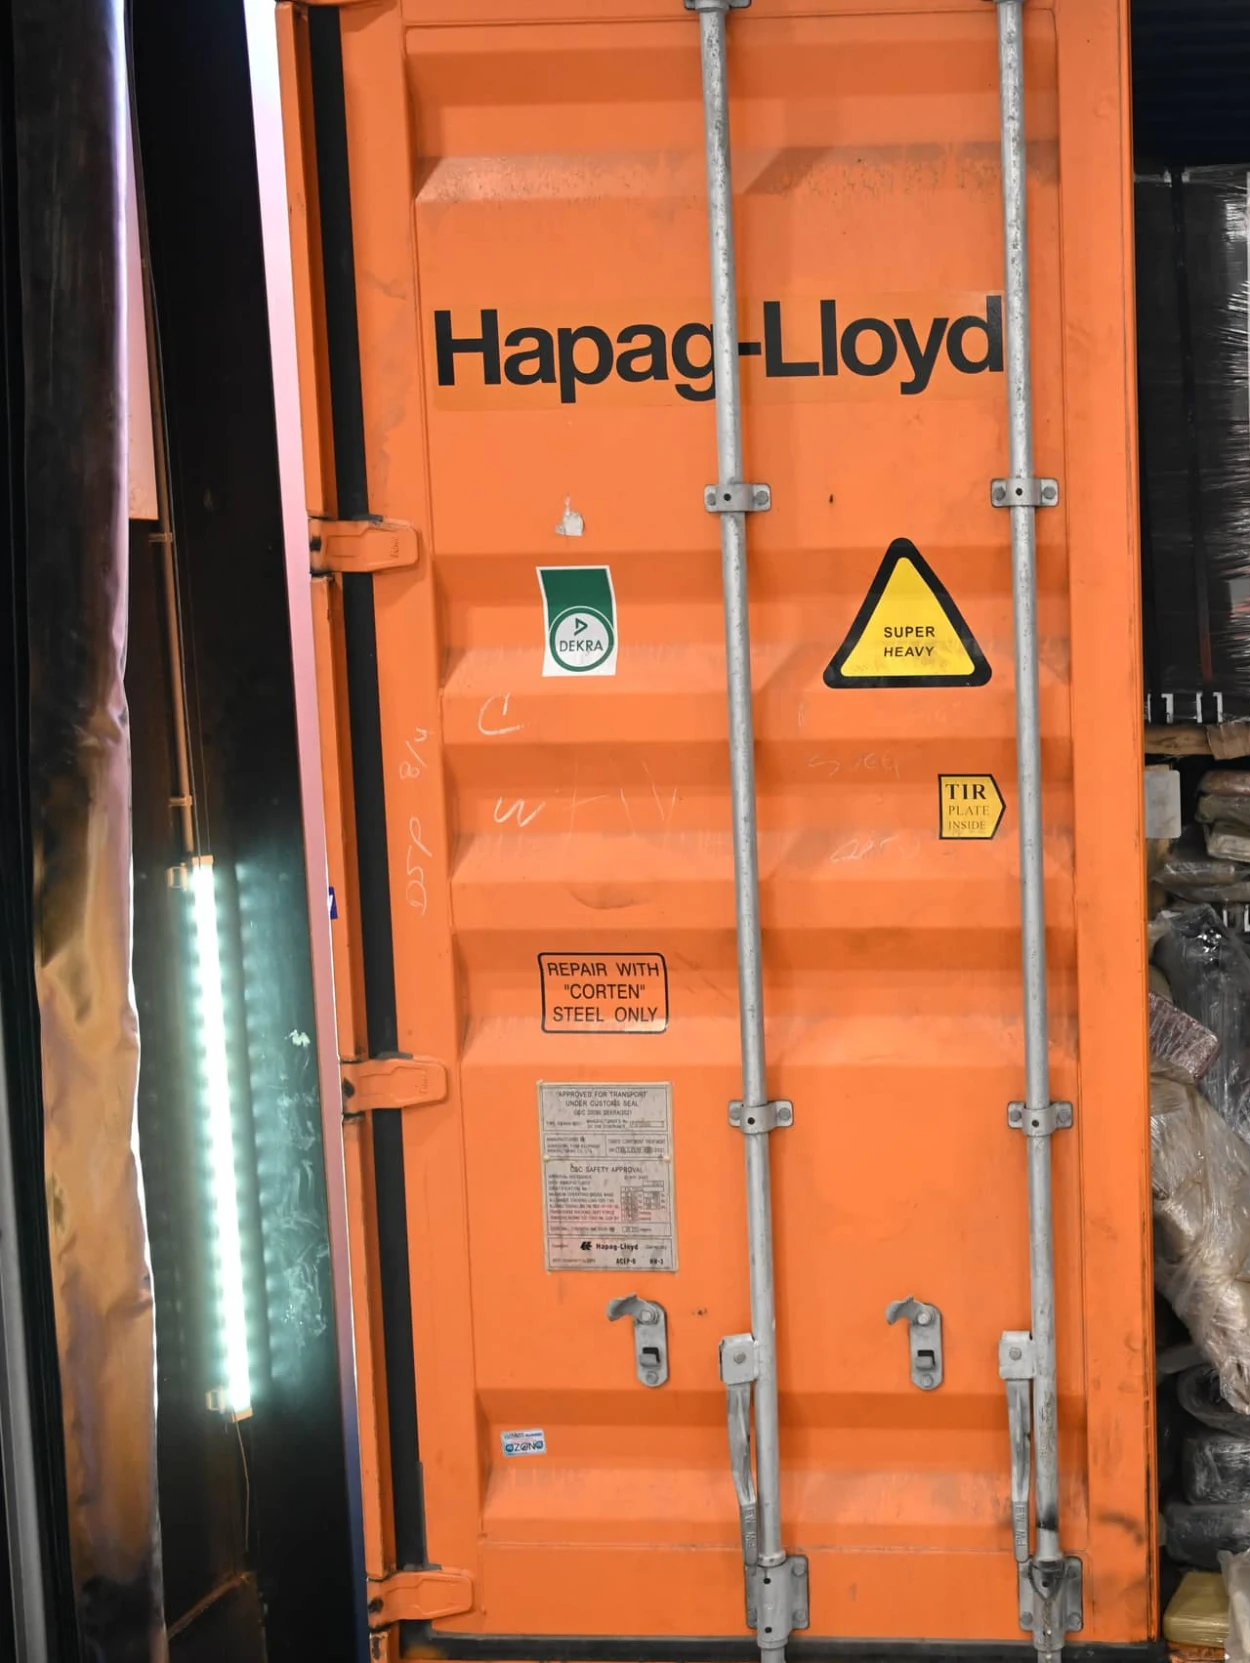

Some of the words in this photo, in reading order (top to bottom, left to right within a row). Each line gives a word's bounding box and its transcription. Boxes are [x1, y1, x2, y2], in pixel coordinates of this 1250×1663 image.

[434, 295, 1005, 404] Hapag-Lloyd
[884, 626, 935, 638] SUPER
[559, 639, 603, 652] DEKRA
[884, 646, 935, 657] HEAVY
[945, 783, 987, 800] TIR
[948, 805, 990, 816] PLATE
[948, 820, 986, 830] INSIDE
[547, 962, 608, 977] REPAIR
[616, 962, 660, 977] WITH
[564, 983, 646, 999] "CORTEN"
[553, 1006, 605, 1022] STEEL
[614, 1006, 658, 1022] ONLY
[594, 1090, 607, 1098] FOR
[585, 1165, 609, 1173] SAFETY
[611, 1165, 643, 1173] APPROVAL
[595, 1243, 639, 1252] Hapag-Lloyd
